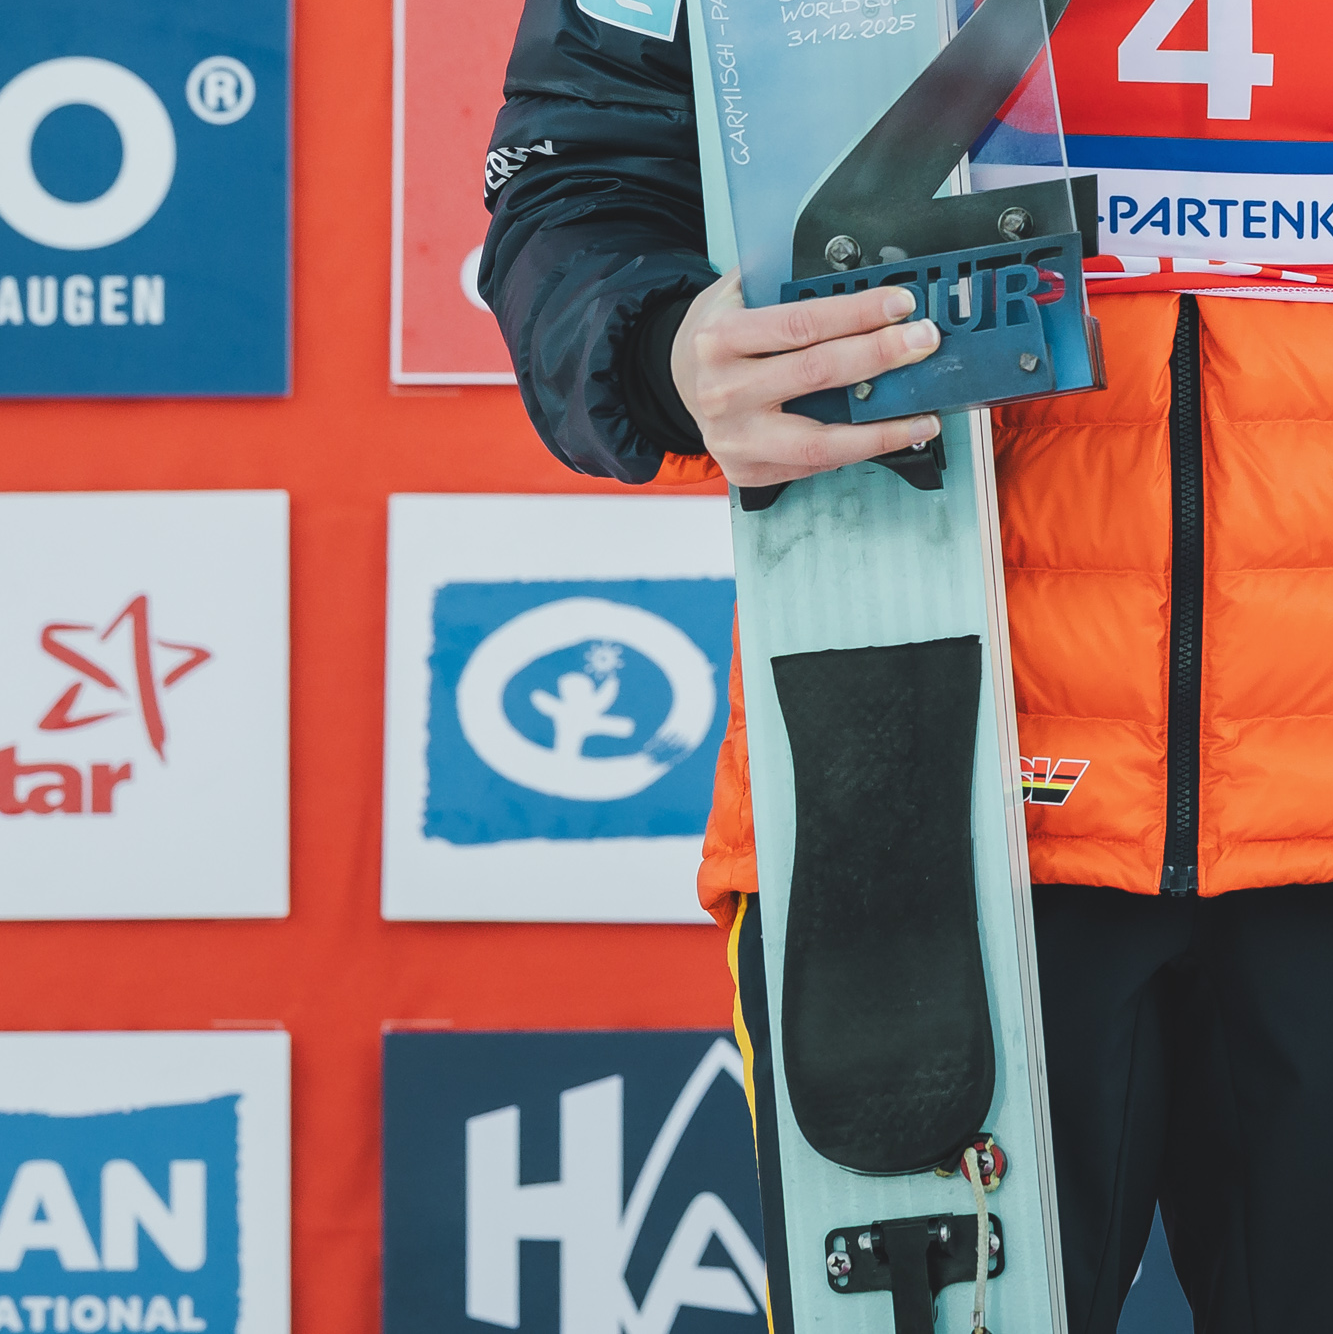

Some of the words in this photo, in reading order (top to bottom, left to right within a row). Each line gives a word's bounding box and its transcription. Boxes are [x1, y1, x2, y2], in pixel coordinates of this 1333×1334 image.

[787, 13, 918, 48] 31.12.2025
[717, 42, 751, 166] GARMISCH
[0, 745, 133, 815] tar
[0, 1294, 207, 1333] ATIONAL
